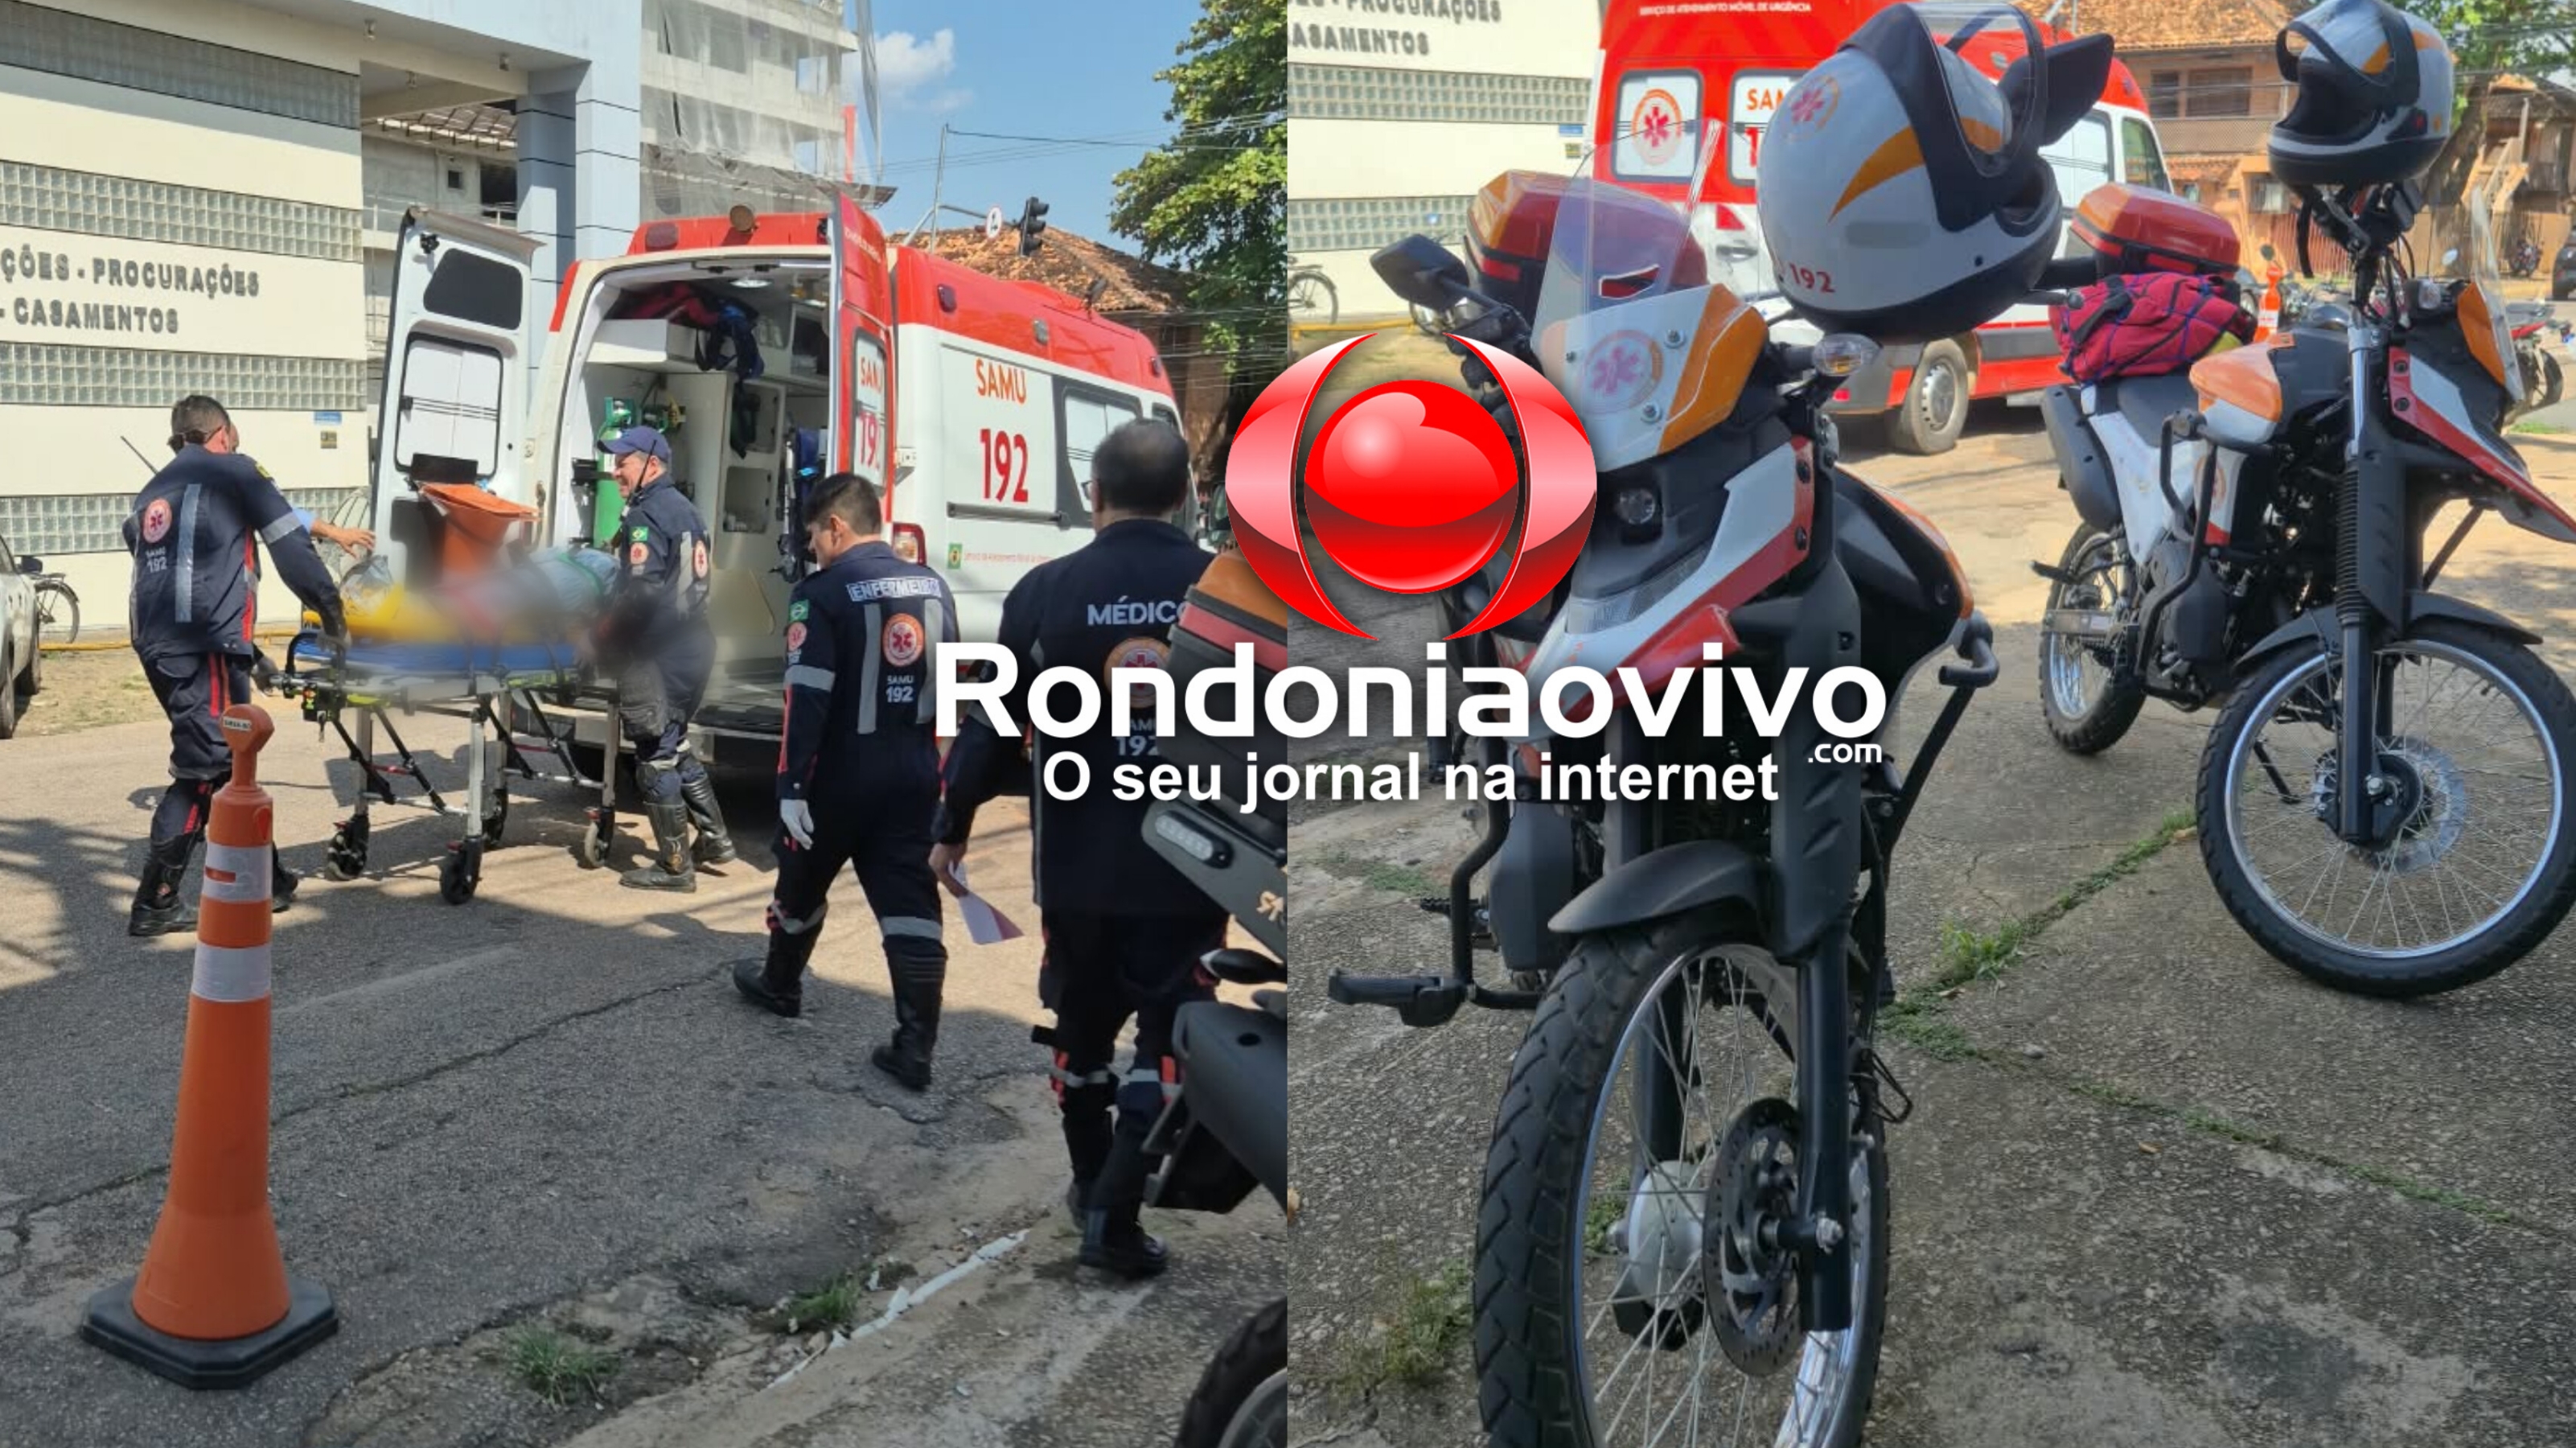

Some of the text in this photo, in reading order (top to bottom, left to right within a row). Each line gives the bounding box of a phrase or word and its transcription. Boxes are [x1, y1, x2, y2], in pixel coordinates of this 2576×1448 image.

[1287, 23, 1429, 56] ASAMENTOS
[1746, 88, 1785, 111] SA
[92, 257, 259, 299] PROCURAÇÕES
[1789, 262, 1835, 294] 192
[14, 298, 179, 334] CASAMENTOS
[976, 357, 1026, 404] SAMU
[980, 428, 1029, 503] 192
[885, 686, 914, 703] 192
[887, 675, 914, 685] SAMU
